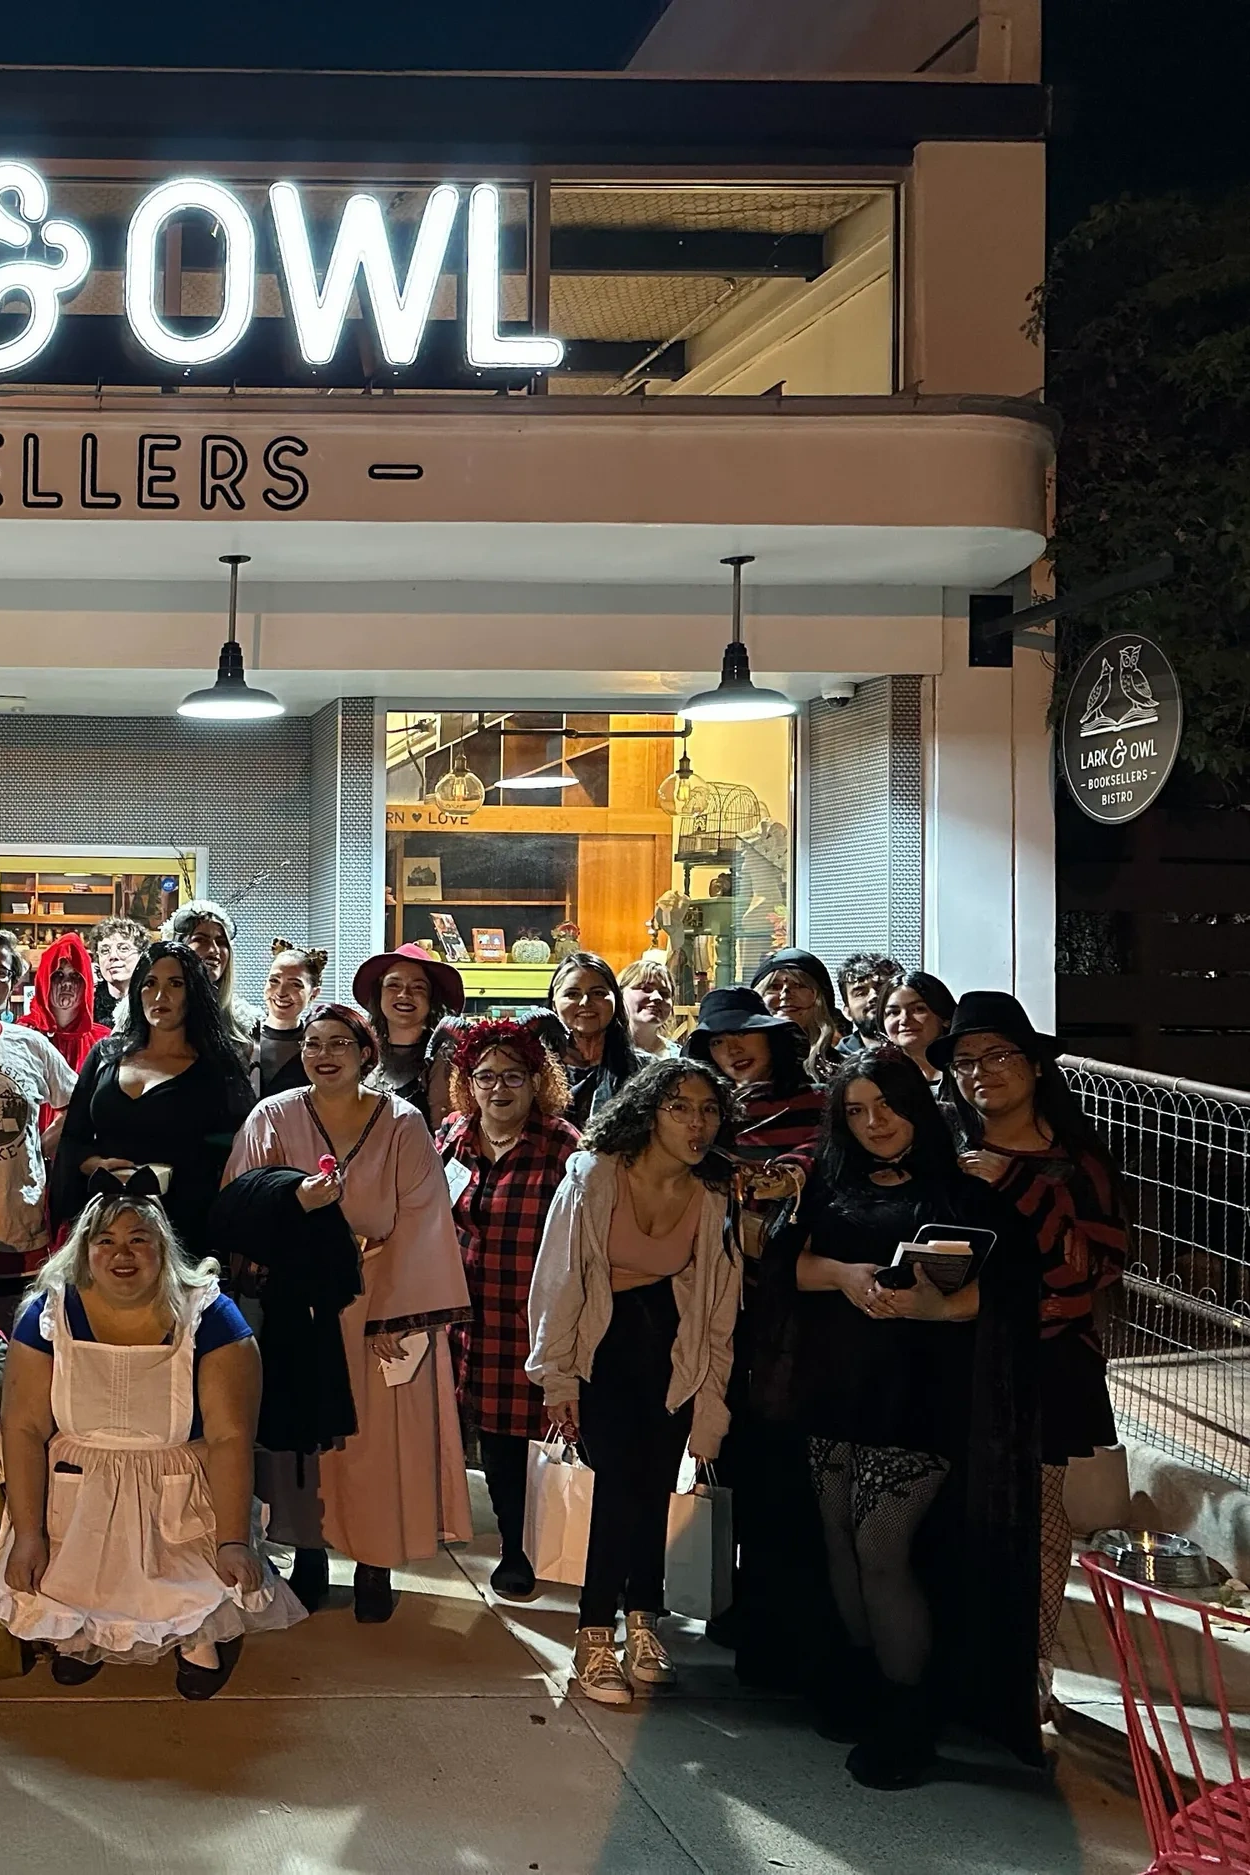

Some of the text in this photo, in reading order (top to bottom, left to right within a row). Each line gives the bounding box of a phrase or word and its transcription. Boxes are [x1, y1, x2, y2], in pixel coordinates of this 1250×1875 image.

[124, 176, 566, 369] OWL
[1080, 738, 1158, 770] LARK & OWL
[1088, 770, 1148, 790] BOOKSELLERS
[1101, 790, 1133, 806] BISTRO
[428, 811, 469, 825] LOVE
